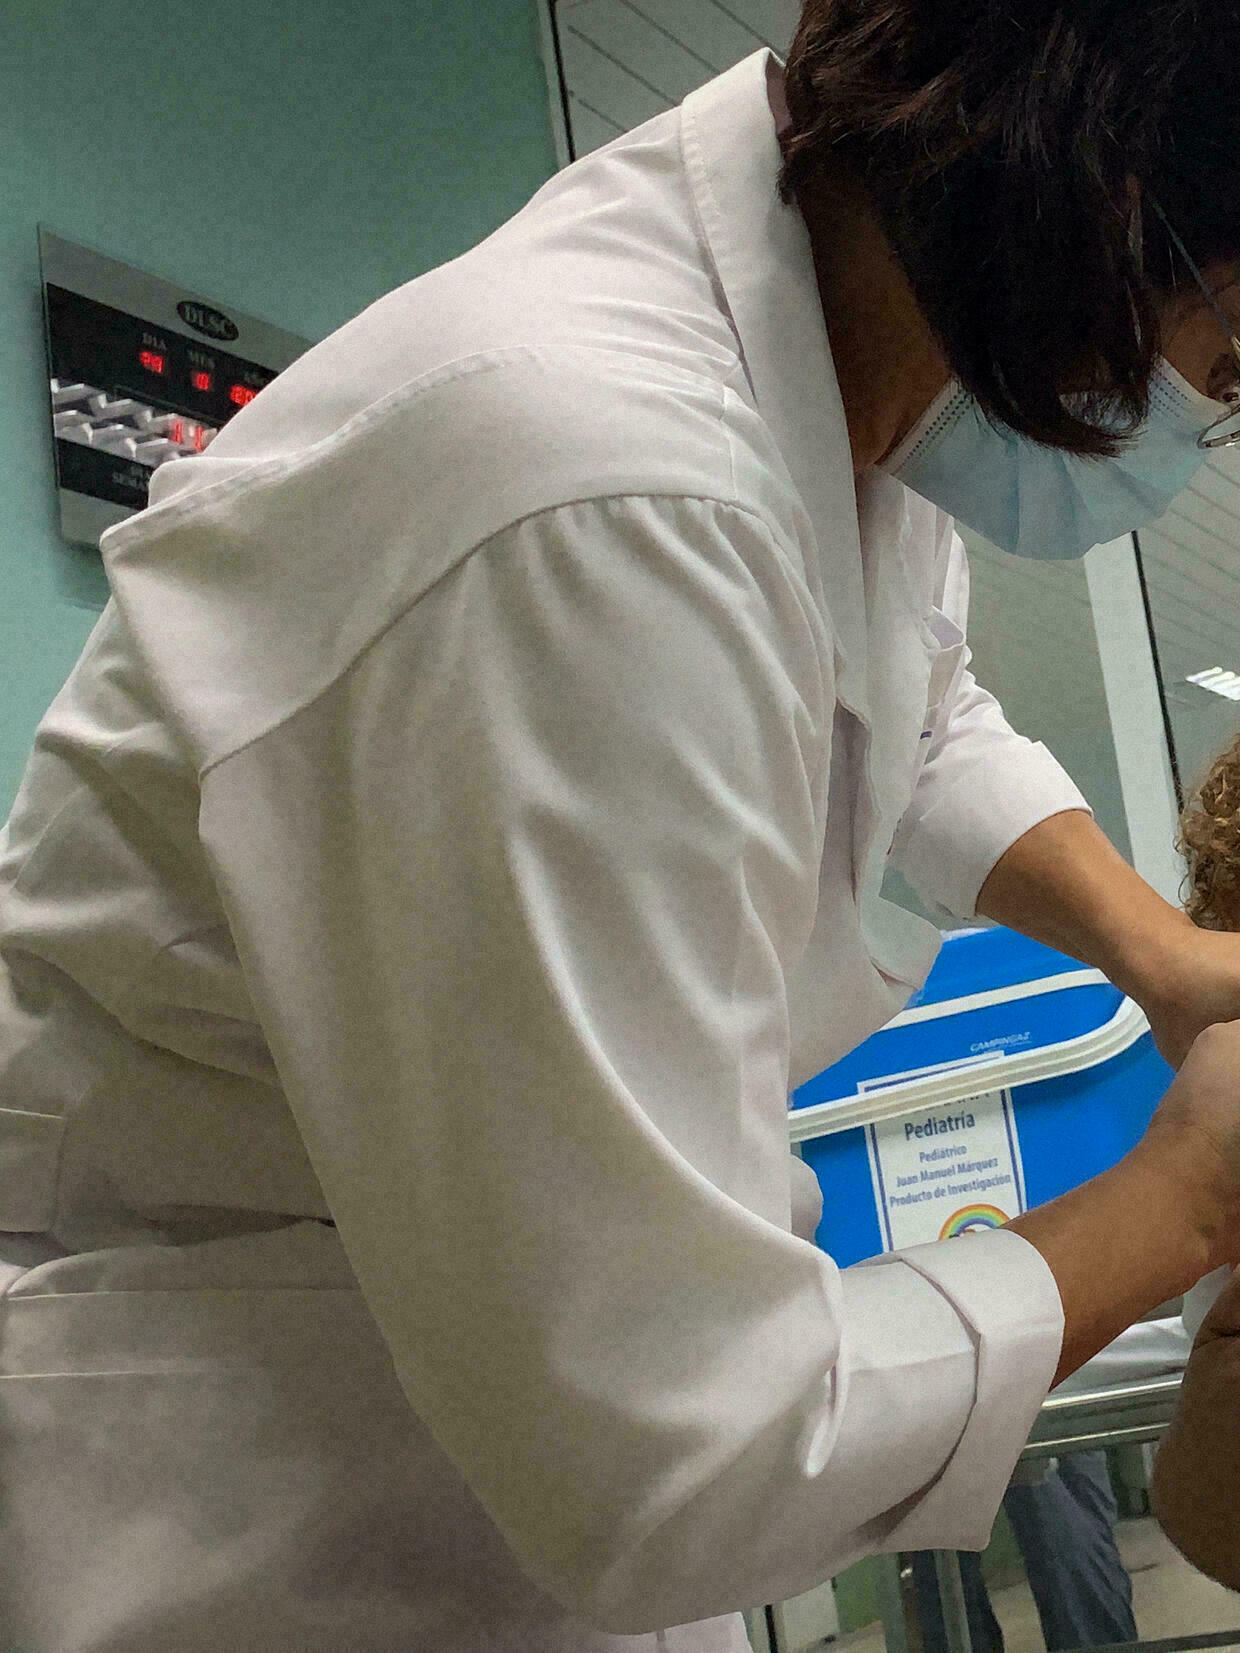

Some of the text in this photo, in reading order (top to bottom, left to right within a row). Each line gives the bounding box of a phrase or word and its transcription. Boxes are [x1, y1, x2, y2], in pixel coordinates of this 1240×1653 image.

[904, 1111, 976, 1141] Pediatría
[897, 1174, 919, 1188] Juan
[920, 1165, 956, 1182] Manuel
[889, 1190, 933, 1208] Producto
[934, 1186, 946, 1199] de
